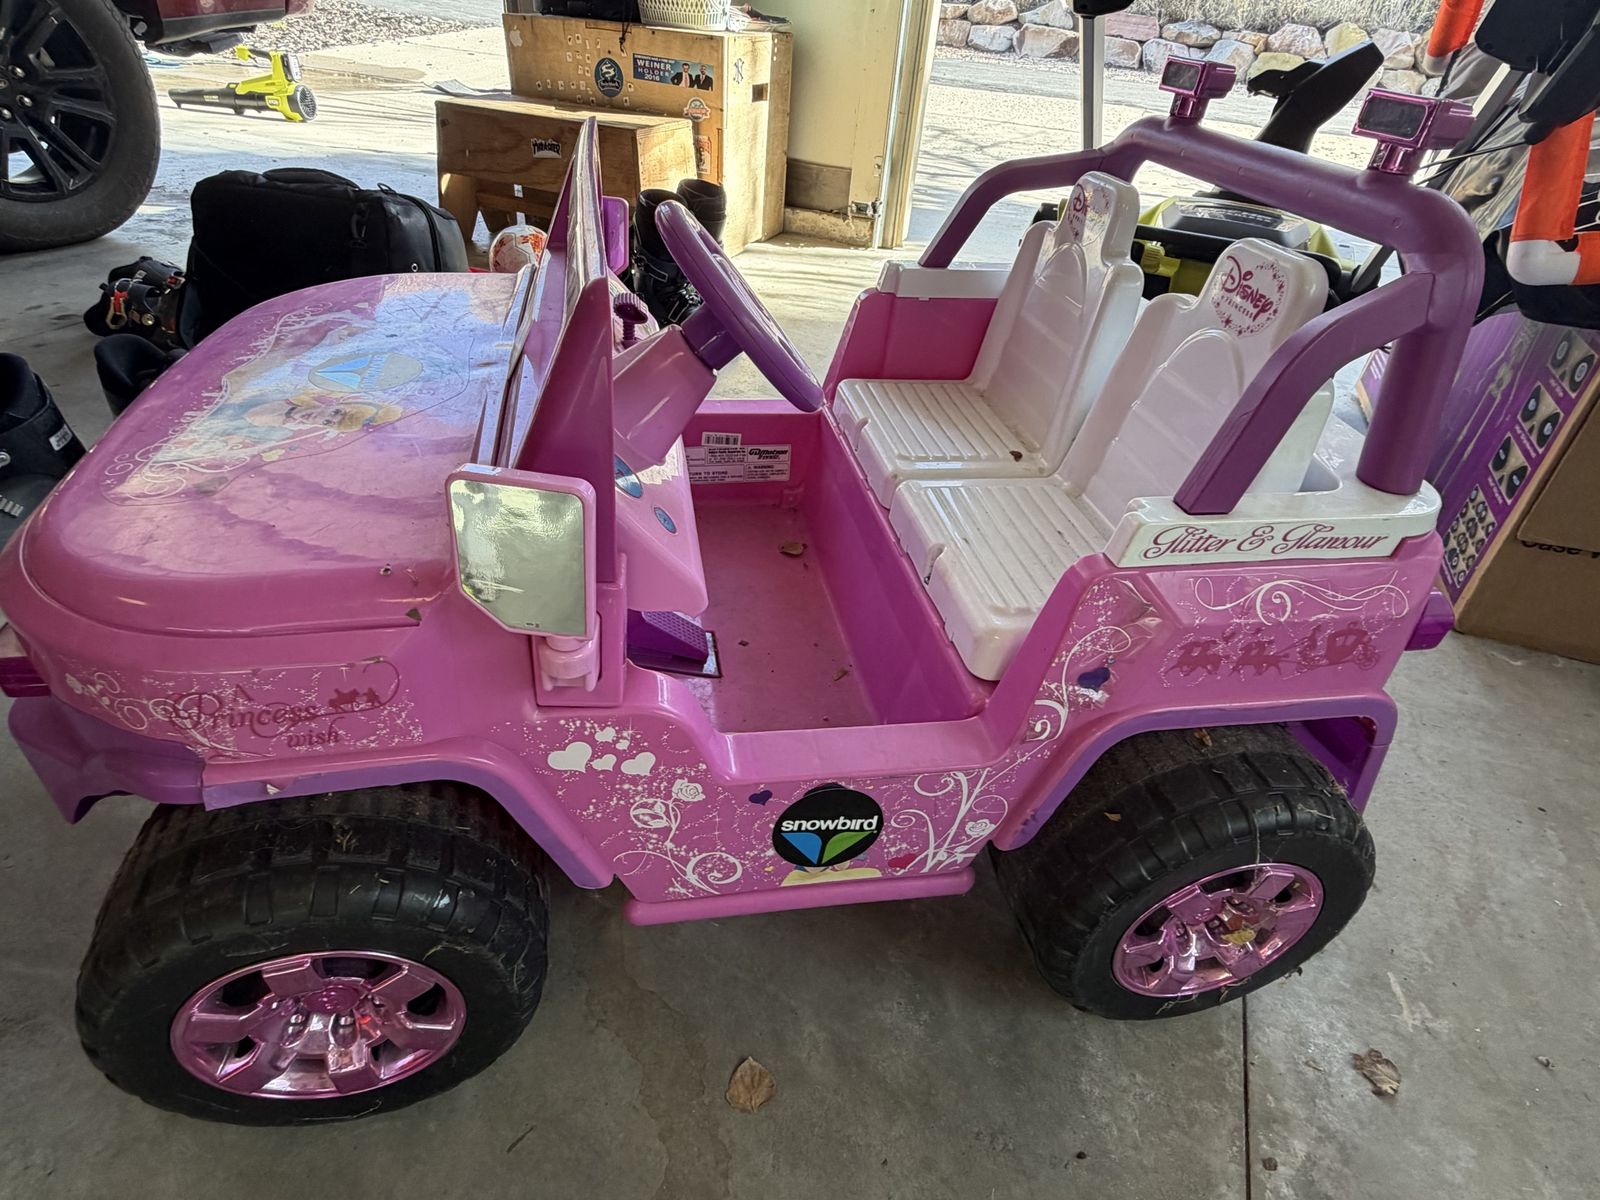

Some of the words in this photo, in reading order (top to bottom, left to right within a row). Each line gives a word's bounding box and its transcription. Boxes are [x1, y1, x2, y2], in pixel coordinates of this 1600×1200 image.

[636, 59, 672, 71] WEINER
[644, 73, 660, 81] 2016
[1222, 255, 1274, 322] Disney
[1143, 524, 1236, 560] Glitter
[1236, 525, 1275, 552] &
[1271, 522, 1388, 555] Glamour
[170, 692, 319, 739] Princess
[287, 716, 345, 748] wish
[781, 815, 879, 832] snowbird
